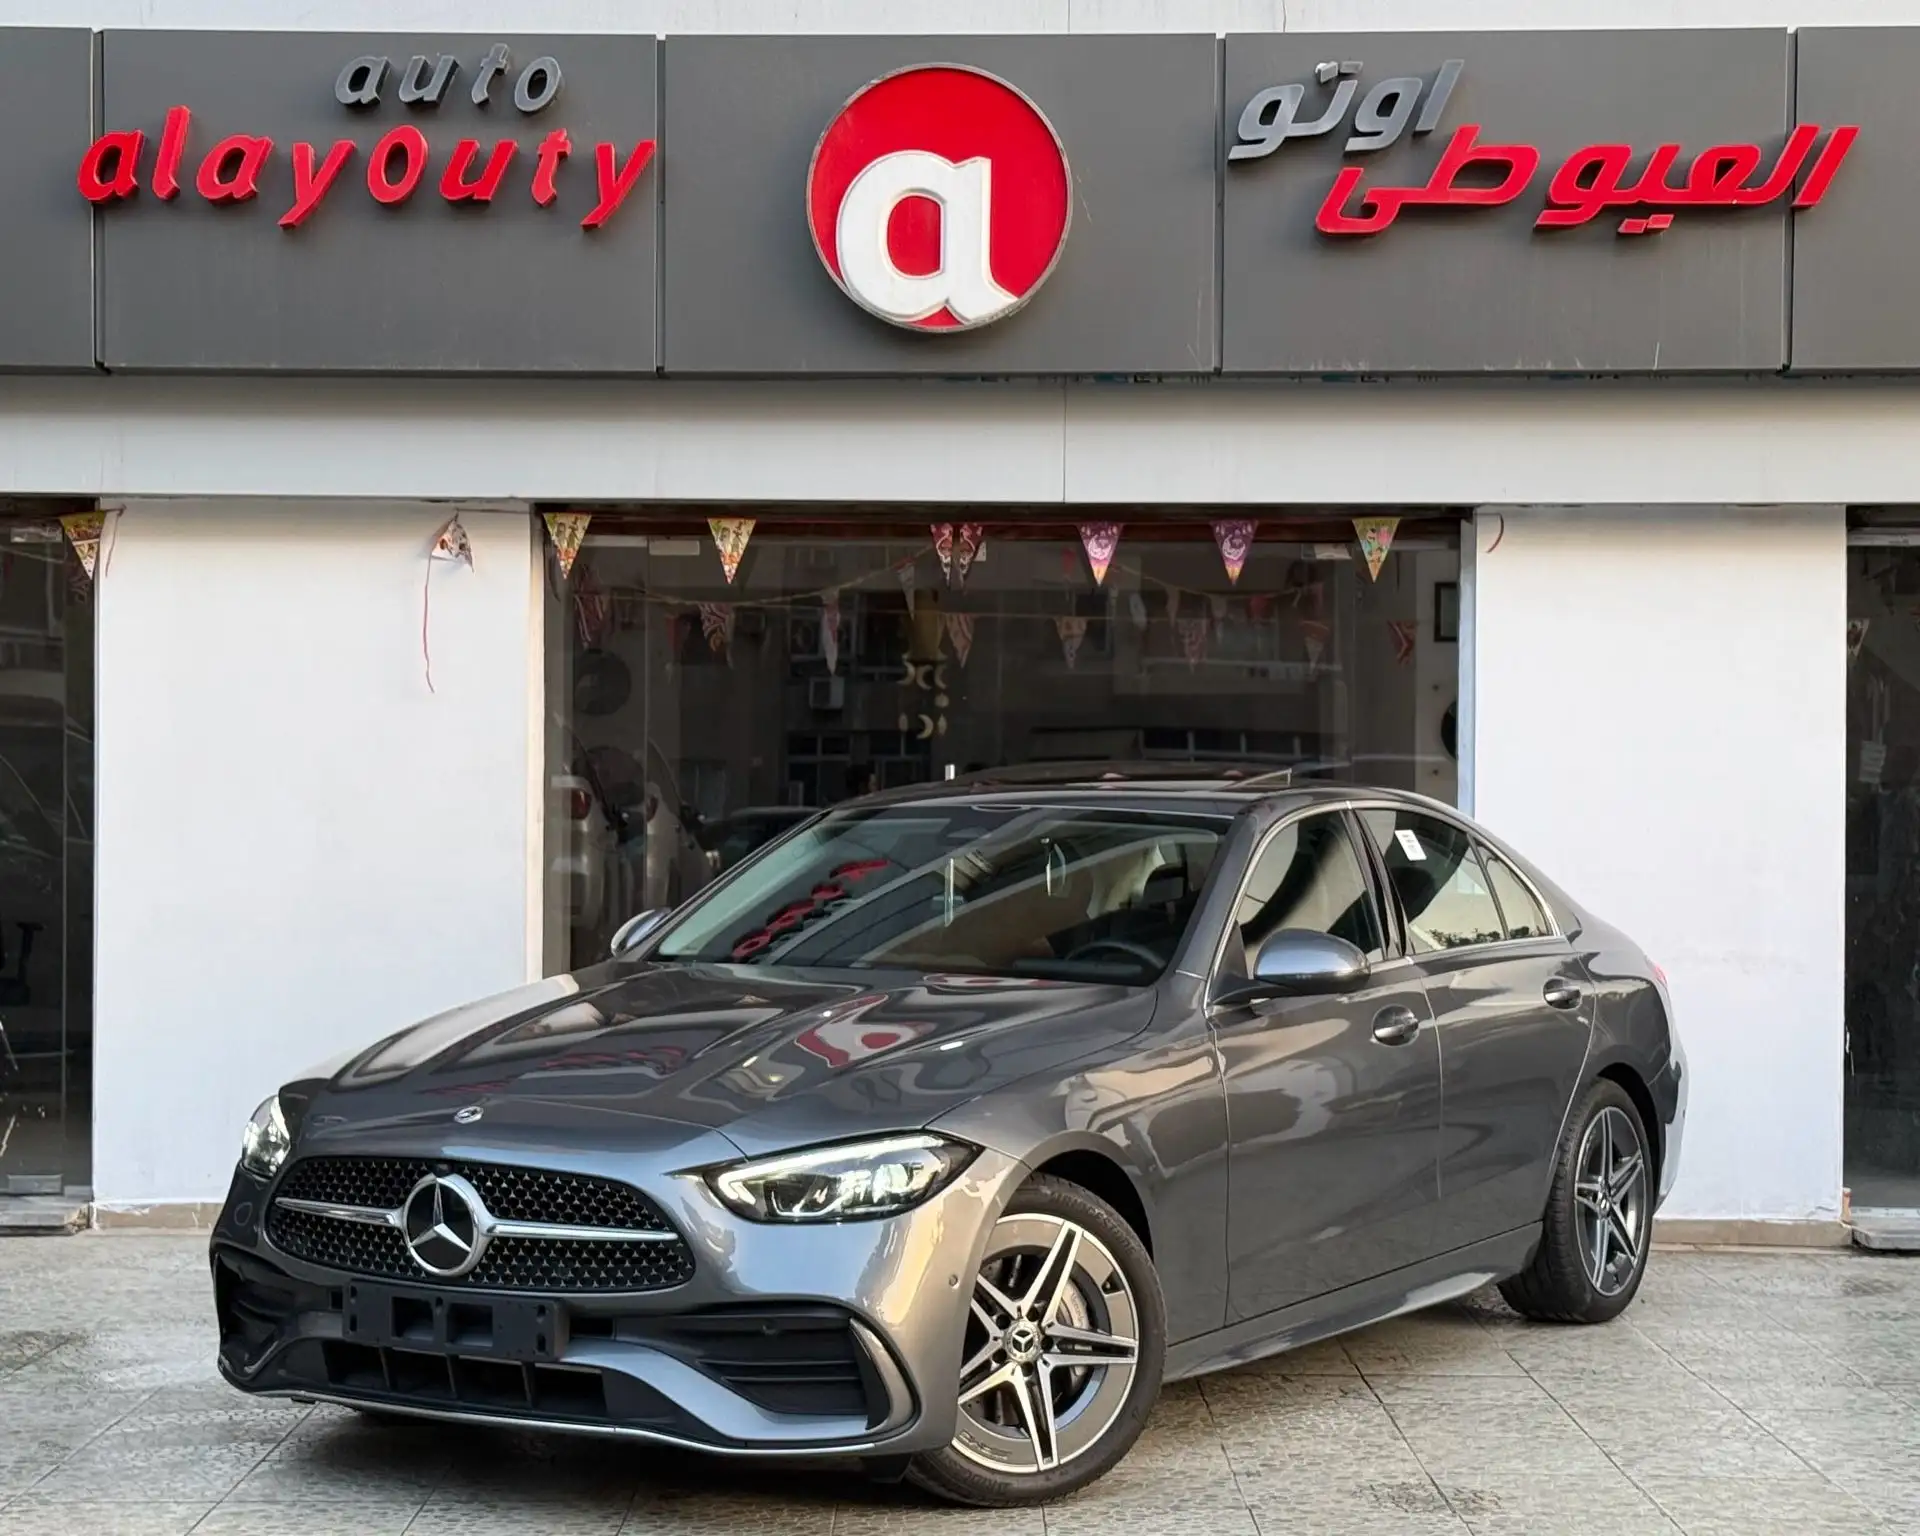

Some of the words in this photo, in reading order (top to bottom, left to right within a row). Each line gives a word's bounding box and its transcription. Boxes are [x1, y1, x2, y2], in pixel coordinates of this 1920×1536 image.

[334, 43, 563, 113] auto
[1228, 59, 1464, 160] اوتو
[836, 149, 1018, 324] a
